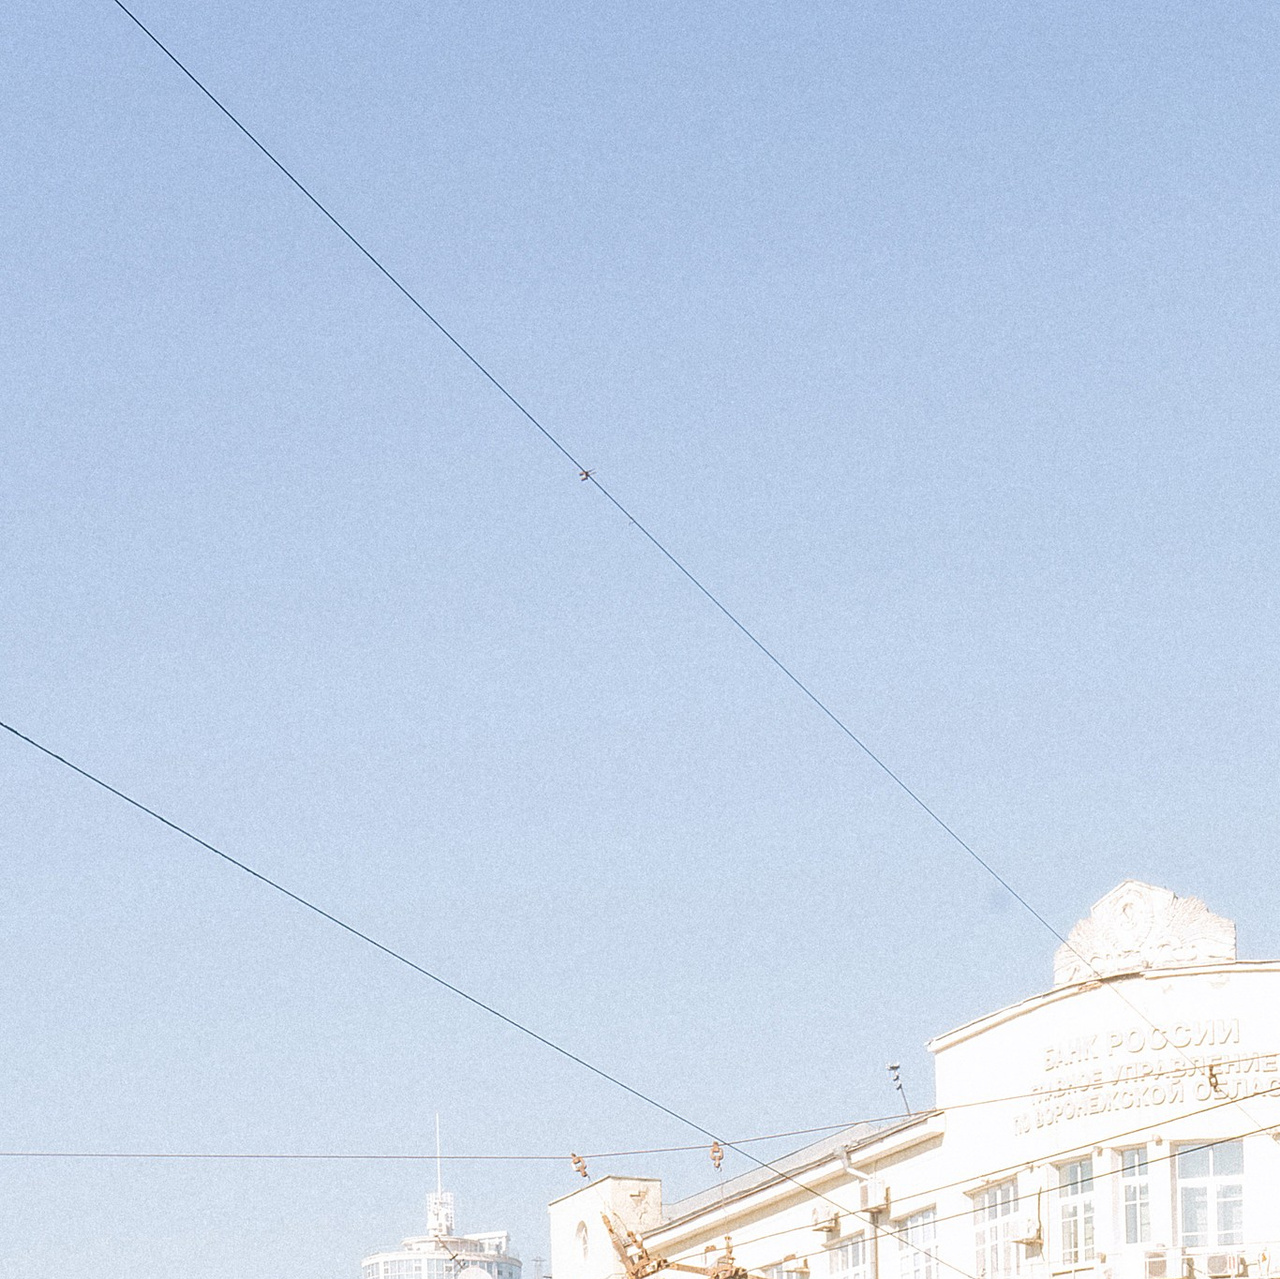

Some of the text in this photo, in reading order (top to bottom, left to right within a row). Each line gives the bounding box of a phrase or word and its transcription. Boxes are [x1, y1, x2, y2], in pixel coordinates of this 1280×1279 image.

[1044, 1018, 1241, 1071] БАНК РОССИИ
[1111, 1053, 1279, 1086] УПРАВЛЕНИЕ
[1036, 1081, 1184, 1129] ВОРОНЕЖСКОЙ
